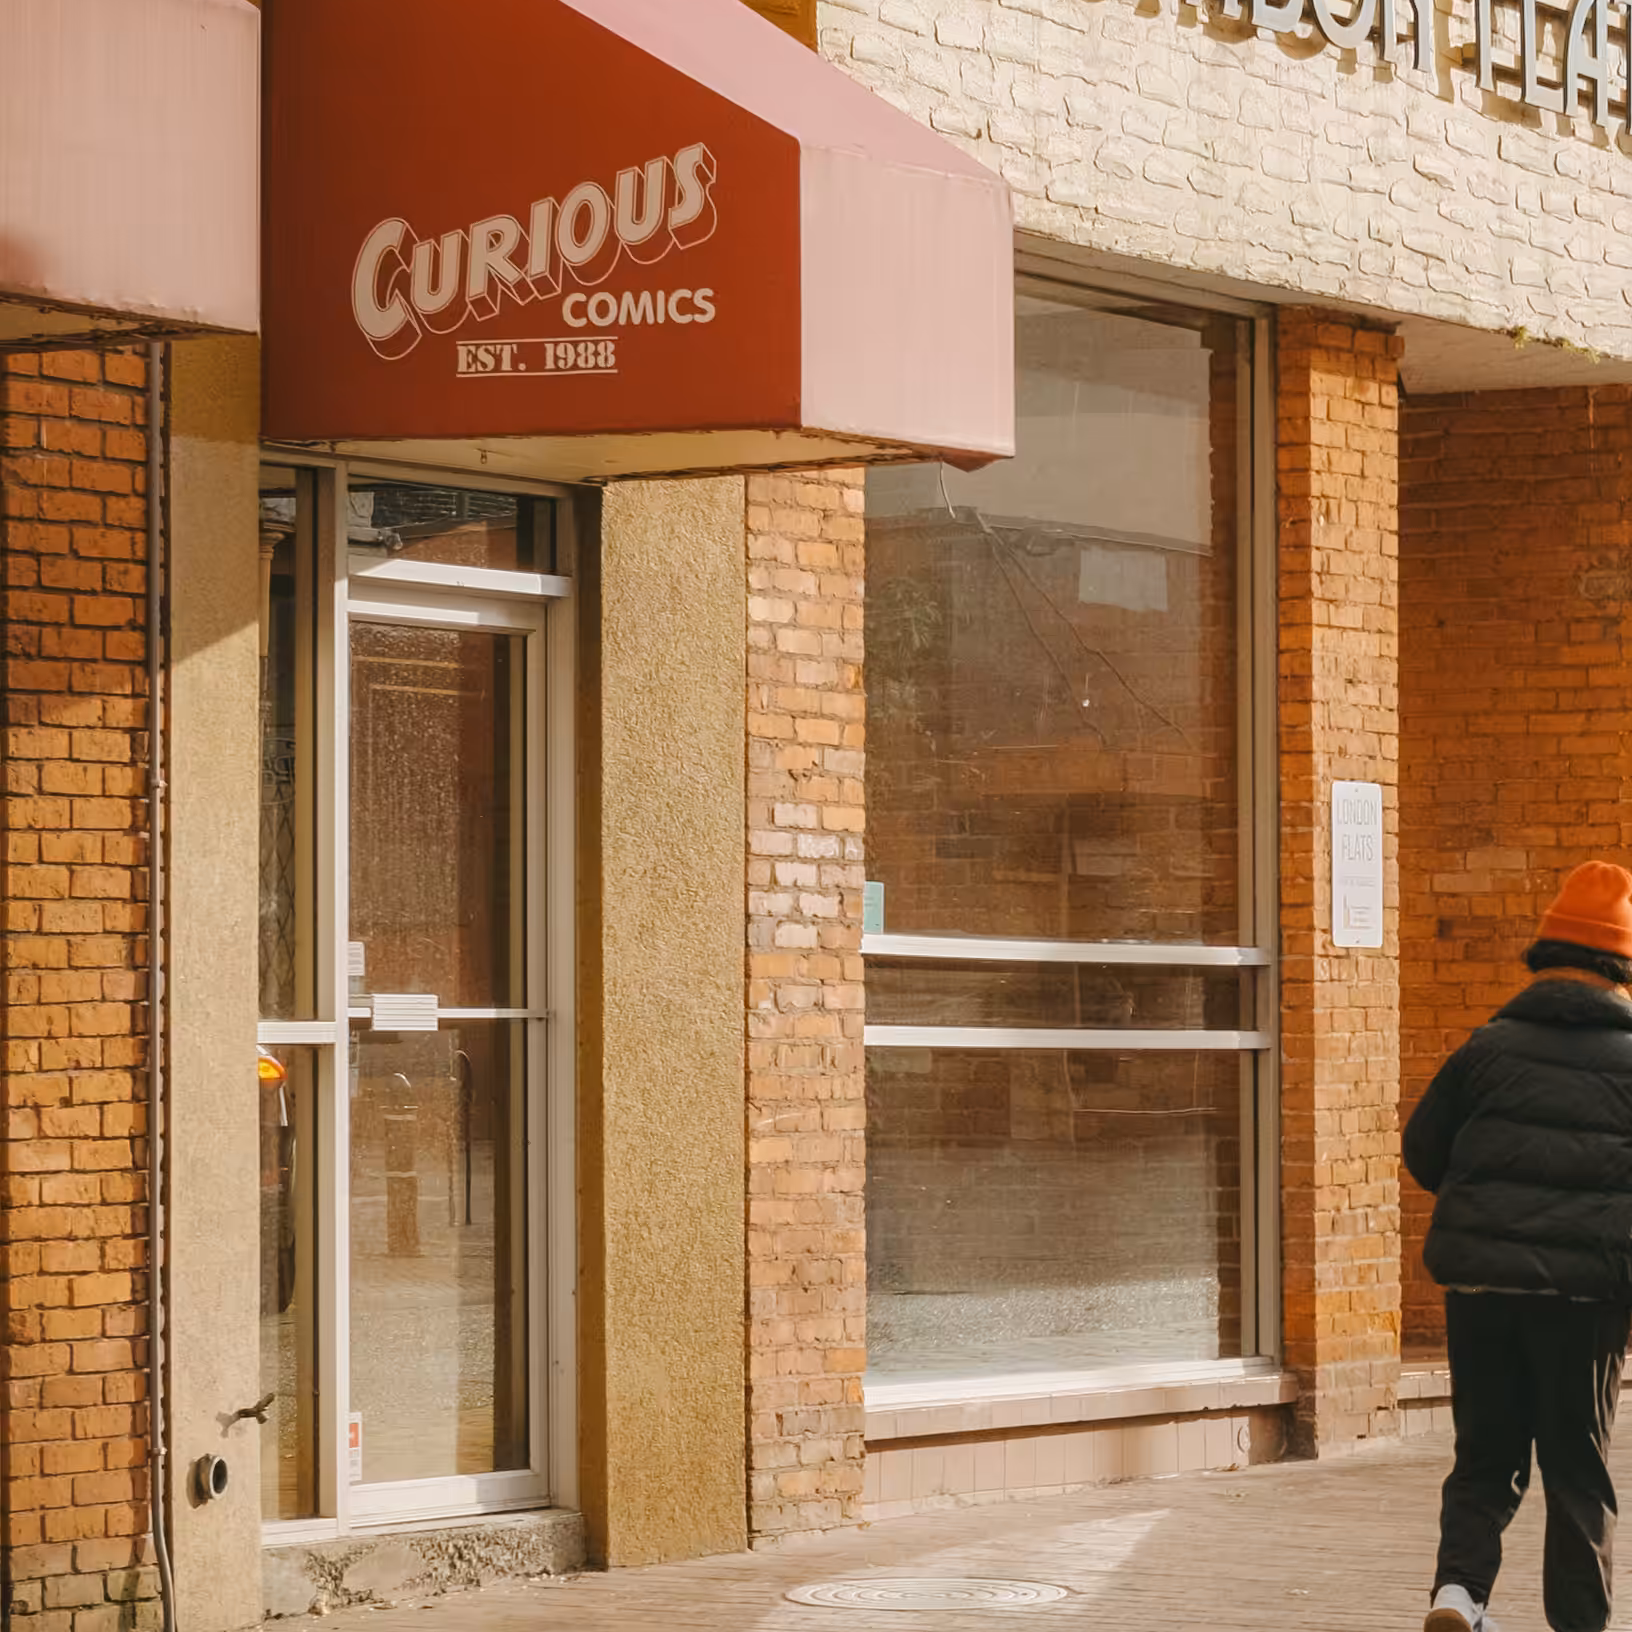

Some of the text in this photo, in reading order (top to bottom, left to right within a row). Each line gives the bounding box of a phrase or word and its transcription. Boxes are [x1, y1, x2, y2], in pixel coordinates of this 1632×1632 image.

[351, 141, 717, 358] CURIOUS
[562, 287, 717, 329] COMICS
[456, 340, 617, 373] EST. 1988
[1336, 799, 1378, 826] LONDON
[1341, 834, 1374, 861] FLATS
